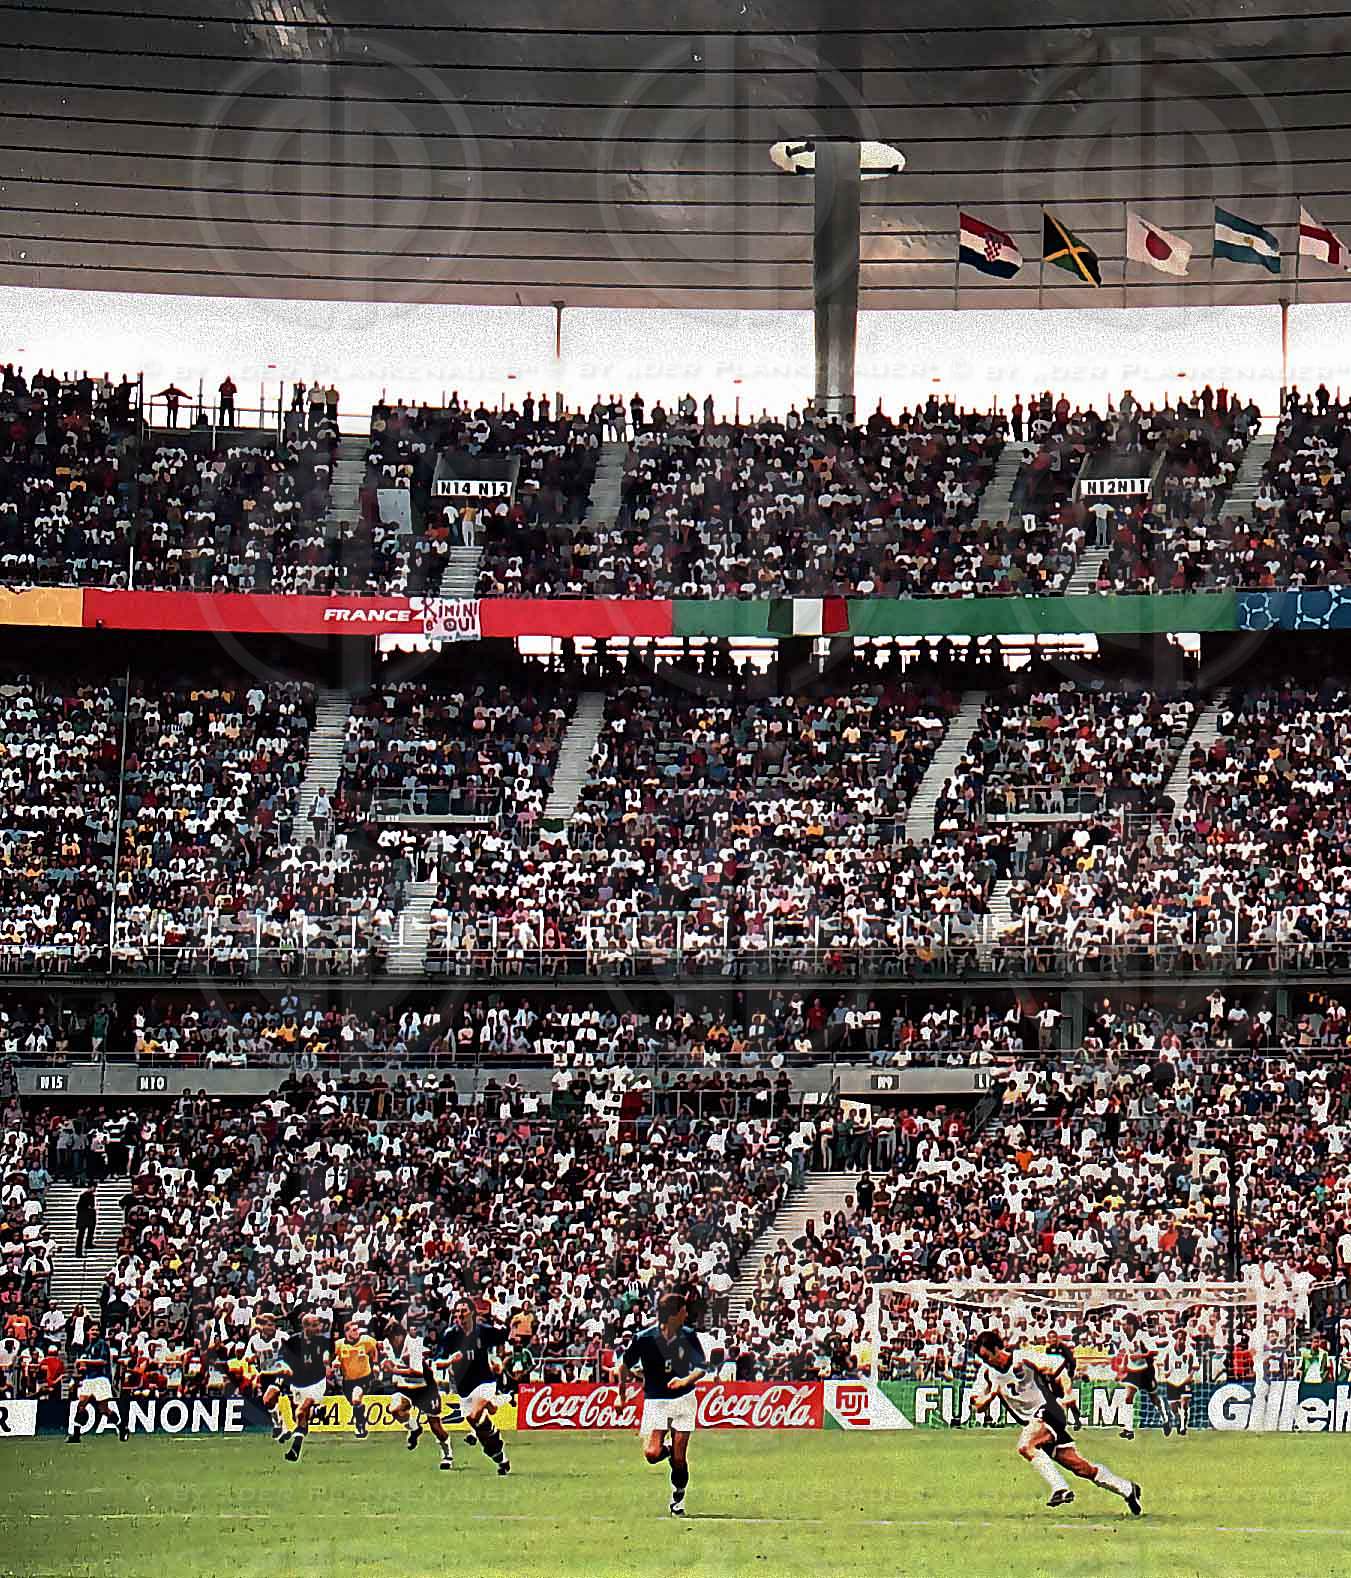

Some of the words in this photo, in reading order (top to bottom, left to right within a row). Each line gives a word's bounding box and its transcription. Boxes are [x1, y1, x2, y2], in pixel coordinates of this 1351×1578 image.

[441, 481, 471, 495] N14
[479, 482, 508, 496] N13
[323, 608, 411, 622] FRANCE
[68, 1399, 245, 1434] DANONE
[696, 1384, 816, 1428] Coca-Cola
